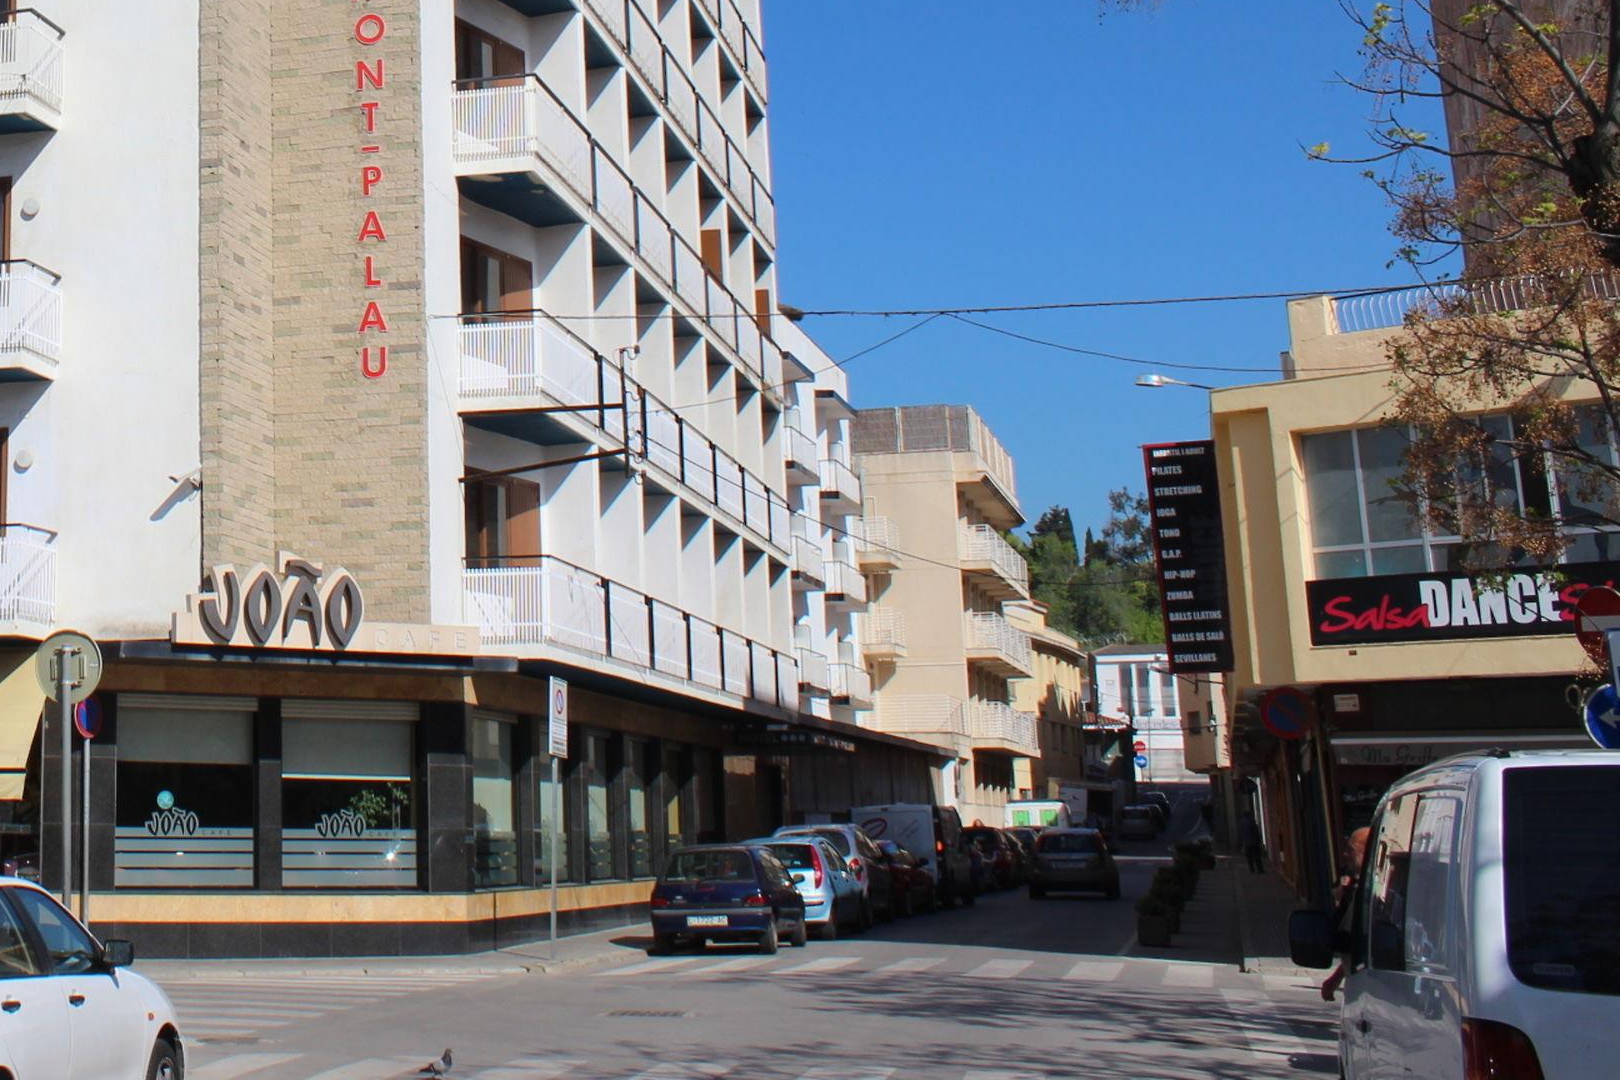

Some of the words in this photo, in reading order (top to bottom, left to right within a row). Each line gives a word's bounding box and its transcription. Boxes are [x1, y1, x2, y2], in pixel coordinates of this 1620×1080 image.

[1151, 465, 1183, 476] PILATES
[1154, 485, 1202, 497] STRETCHING
[1156, 508, 1177, 518] IOGA
[1164, 569, 1196, 580] HIP-HOP
[1166, 590, 1195, 601] ZUMBA
[196, 556, 365, 650] JOÃO
[1320, 593, 1430, 633] Salsa
[1419, 573, 1562, 628] DANCE
[1168, 611, 1192, 622] BALLS
[1193, 610, 1223, 621] LLATINS
[1171, 632, 1195, 643] BALLS
[1196, 631, 1206, 641] DE
[1174, 653, 1217, 663] SEVILLANES
[145, 807, 200, 837] JOÃO
[315, 809, 368, 838] JOÃO
